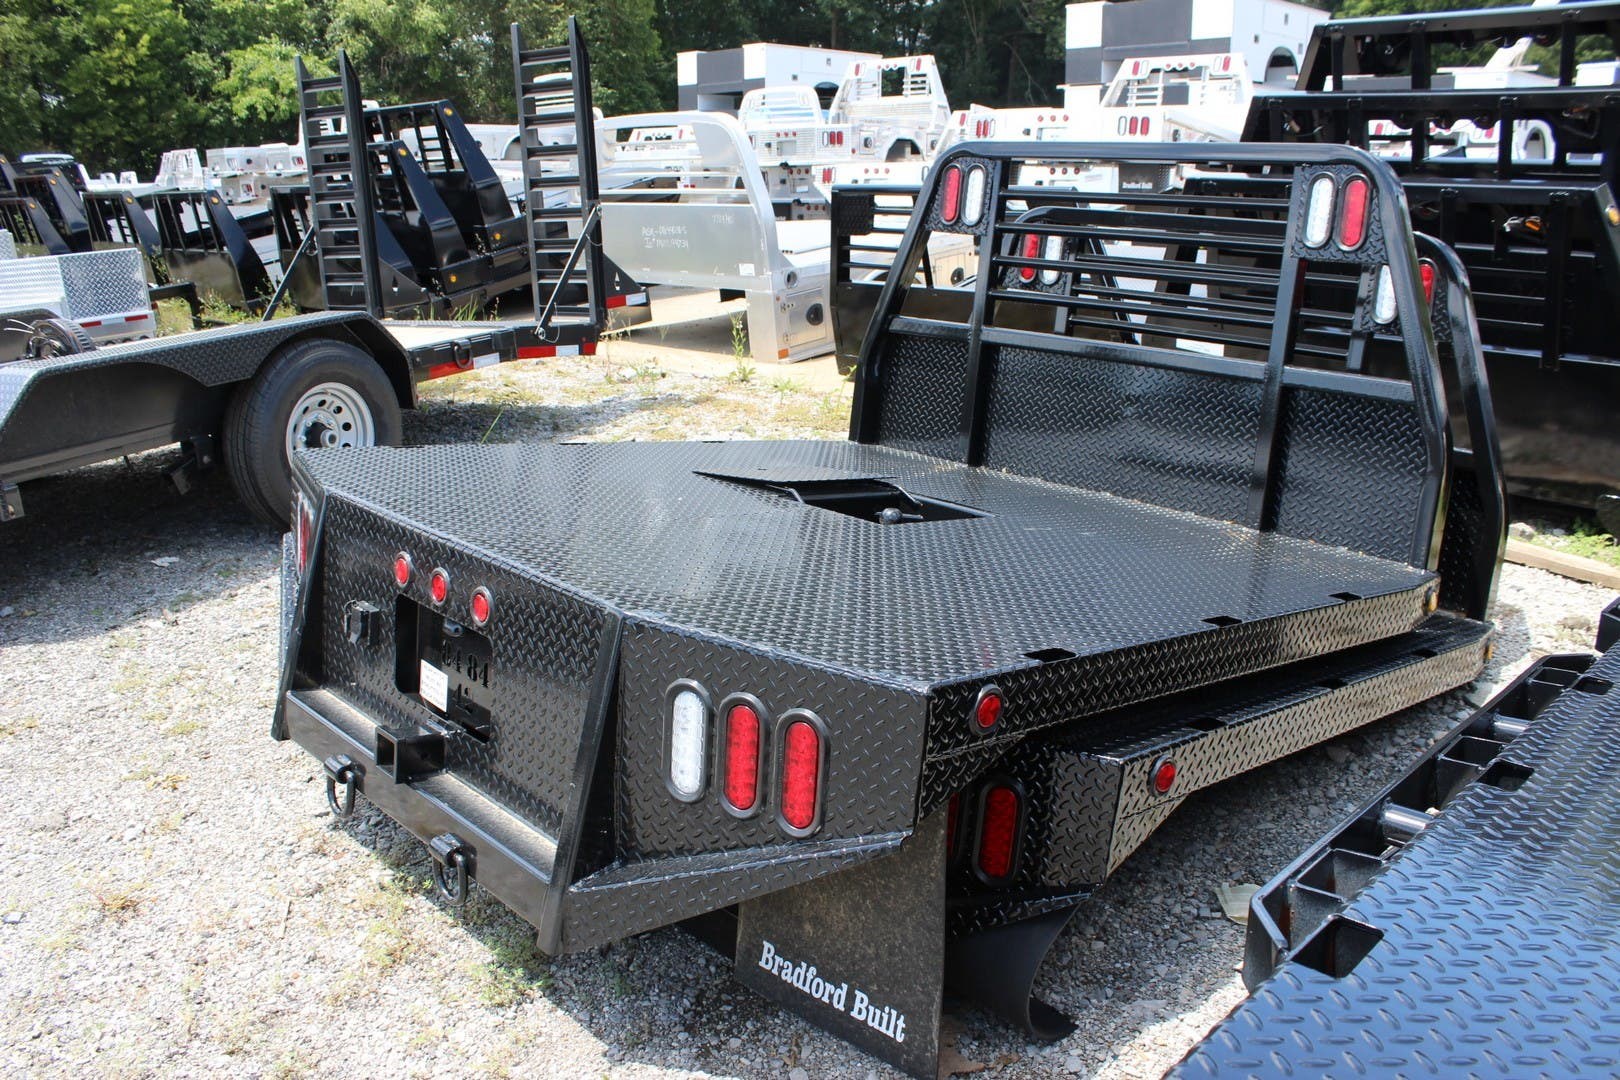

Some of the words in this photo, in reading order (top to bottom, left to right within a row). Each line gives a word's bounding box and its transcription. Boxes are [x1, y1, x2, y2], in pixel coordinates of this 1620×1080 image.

[466, 654, 489, 689] 84
[758, 940, 849, 1012] Bradford
[850, 989, 906, 1043] Built
